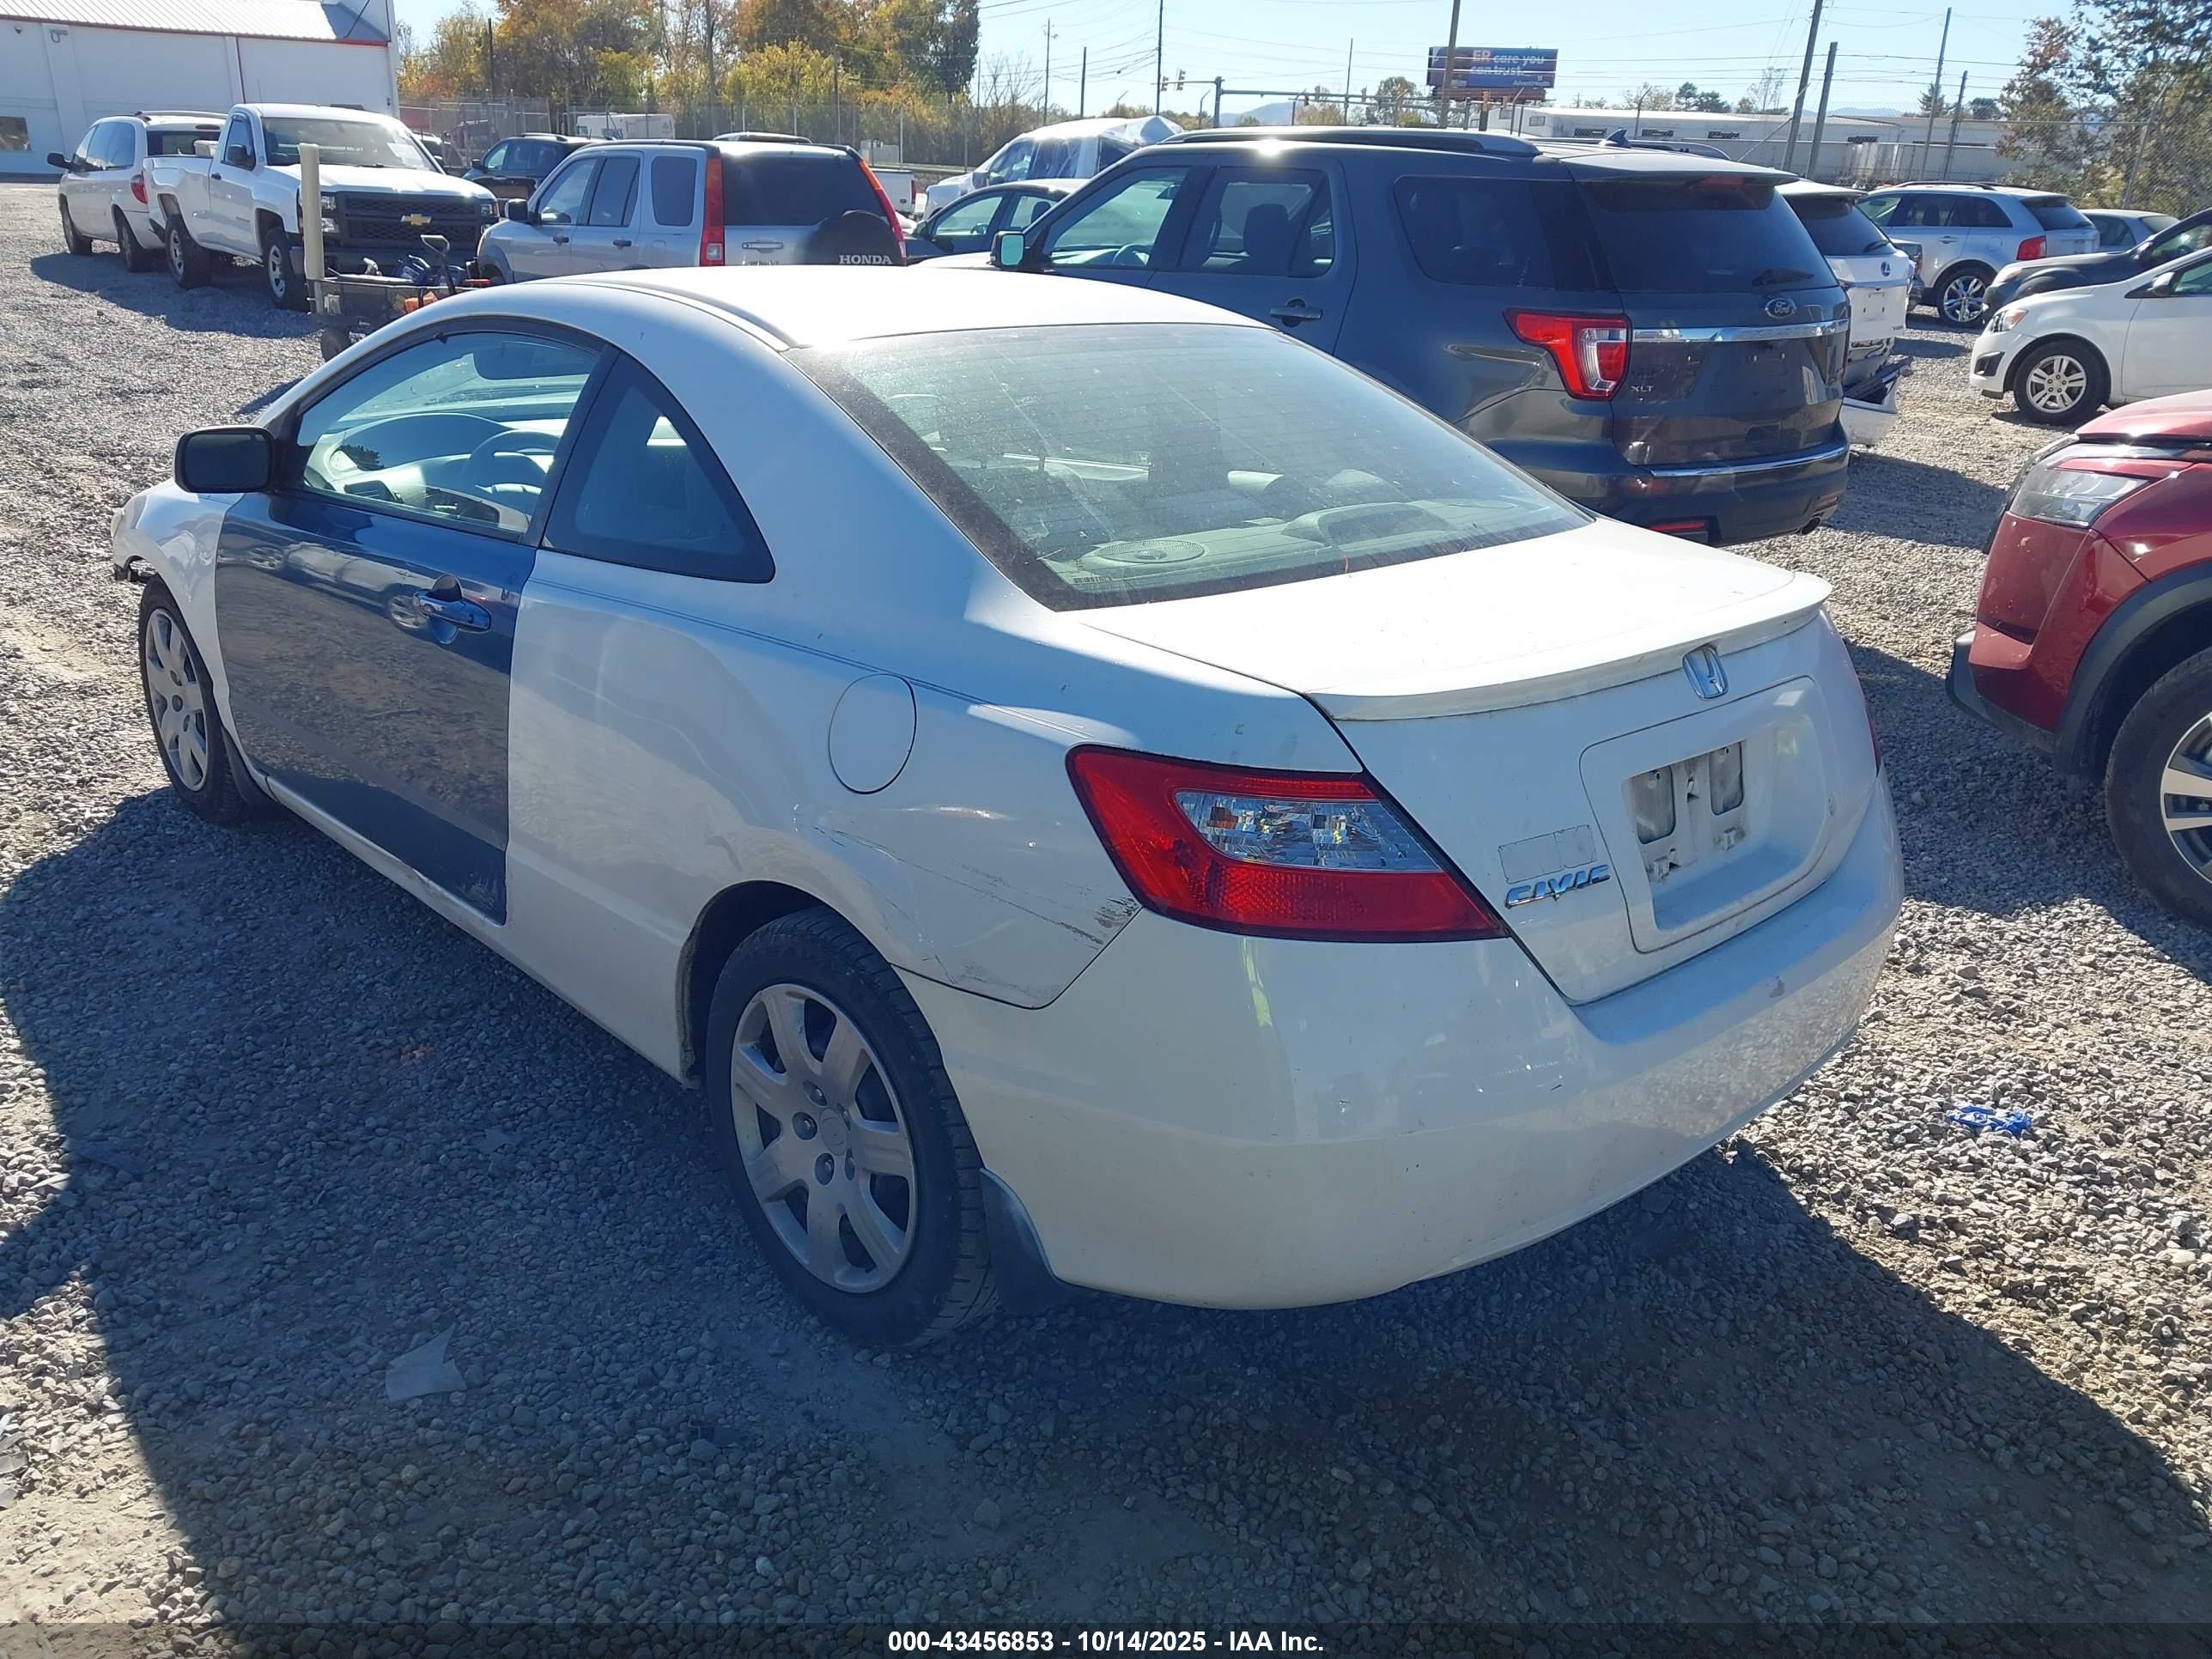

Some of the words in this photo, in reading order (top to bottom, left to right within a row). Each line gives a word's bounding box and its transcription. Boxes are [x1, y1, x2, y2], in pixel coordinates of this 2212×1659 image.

[1473, 50, 1491, 62] ER
[1493, 54, 1519, 64] care
[1522, 56, 1544, 66] you
[1470, 65, 1492, 75] can
[839, 254, 893, 265] HONDA
[1504, 864, 1611, 908] CIVIC
